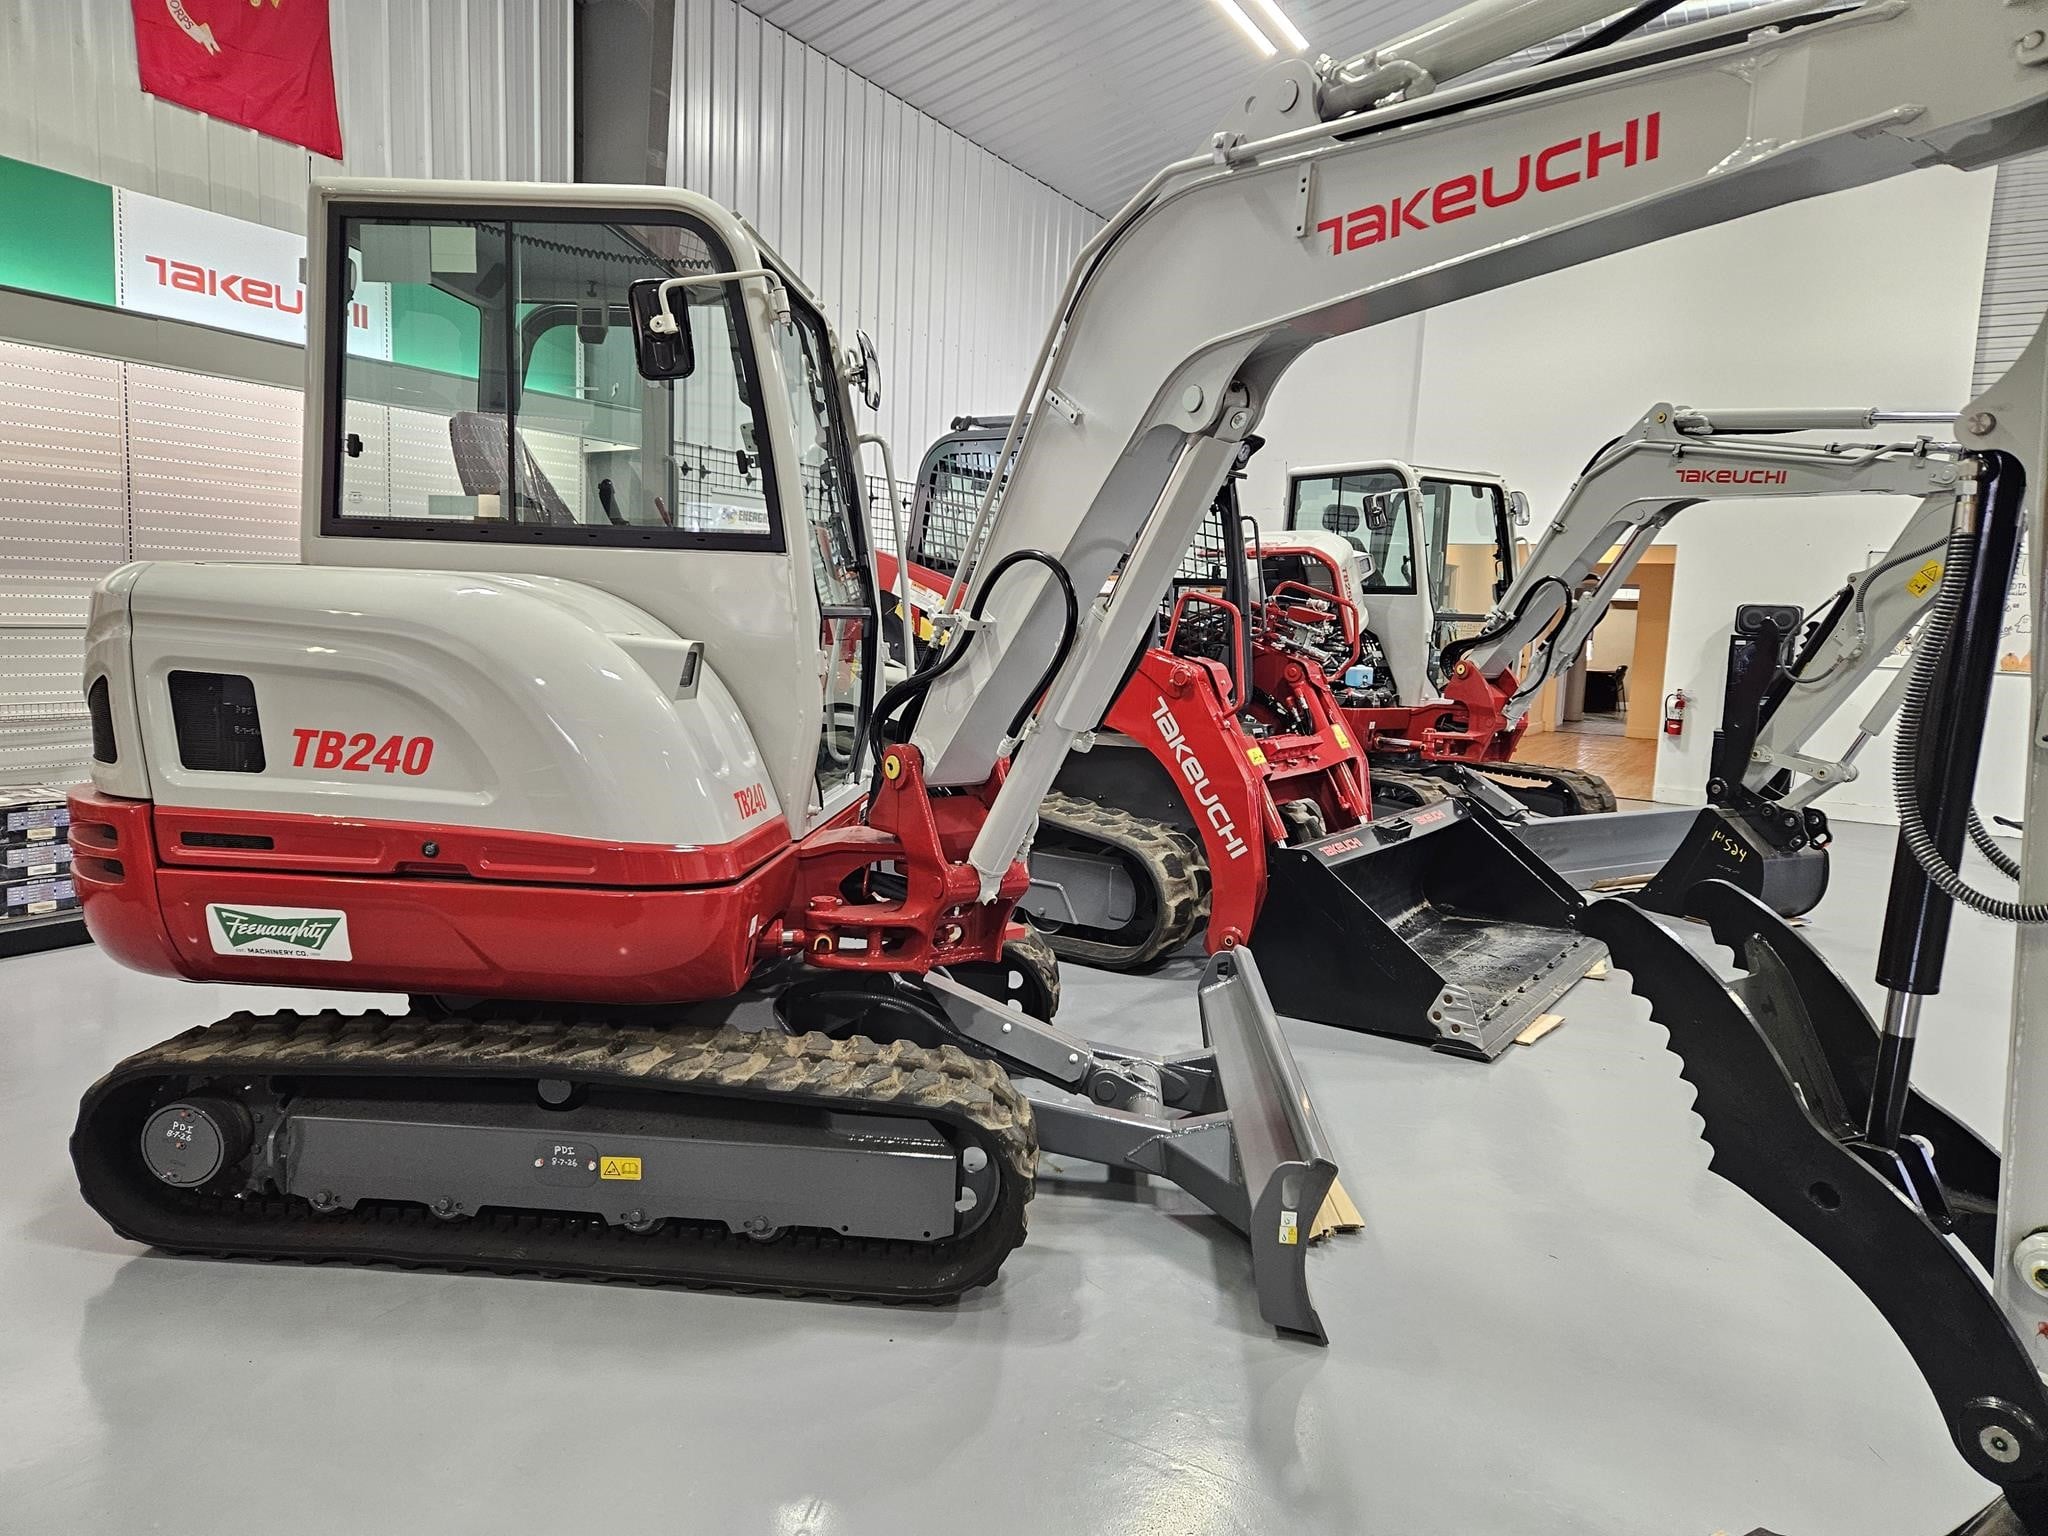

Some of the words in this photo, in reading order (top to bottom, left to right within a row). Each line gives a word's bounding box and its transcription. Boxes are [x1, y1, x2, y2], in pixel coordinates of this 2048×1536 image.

[1317, 111, 1661, 257] TAKEUCHI
[1675, 469, 1788, 484] TAKEUCHI
[291, 728, 435, 777] TB240
[1151, 695, 1249, 860] TAKEUCHI
[733, 783, 768, 820] TB240
[220, 911, 333, 949] Feenaughty
[247, 948, 294, 956] MACHINERY
[172, 1121, 194, 1135] PDI
[554, 1145, 576, 1156] PDI
